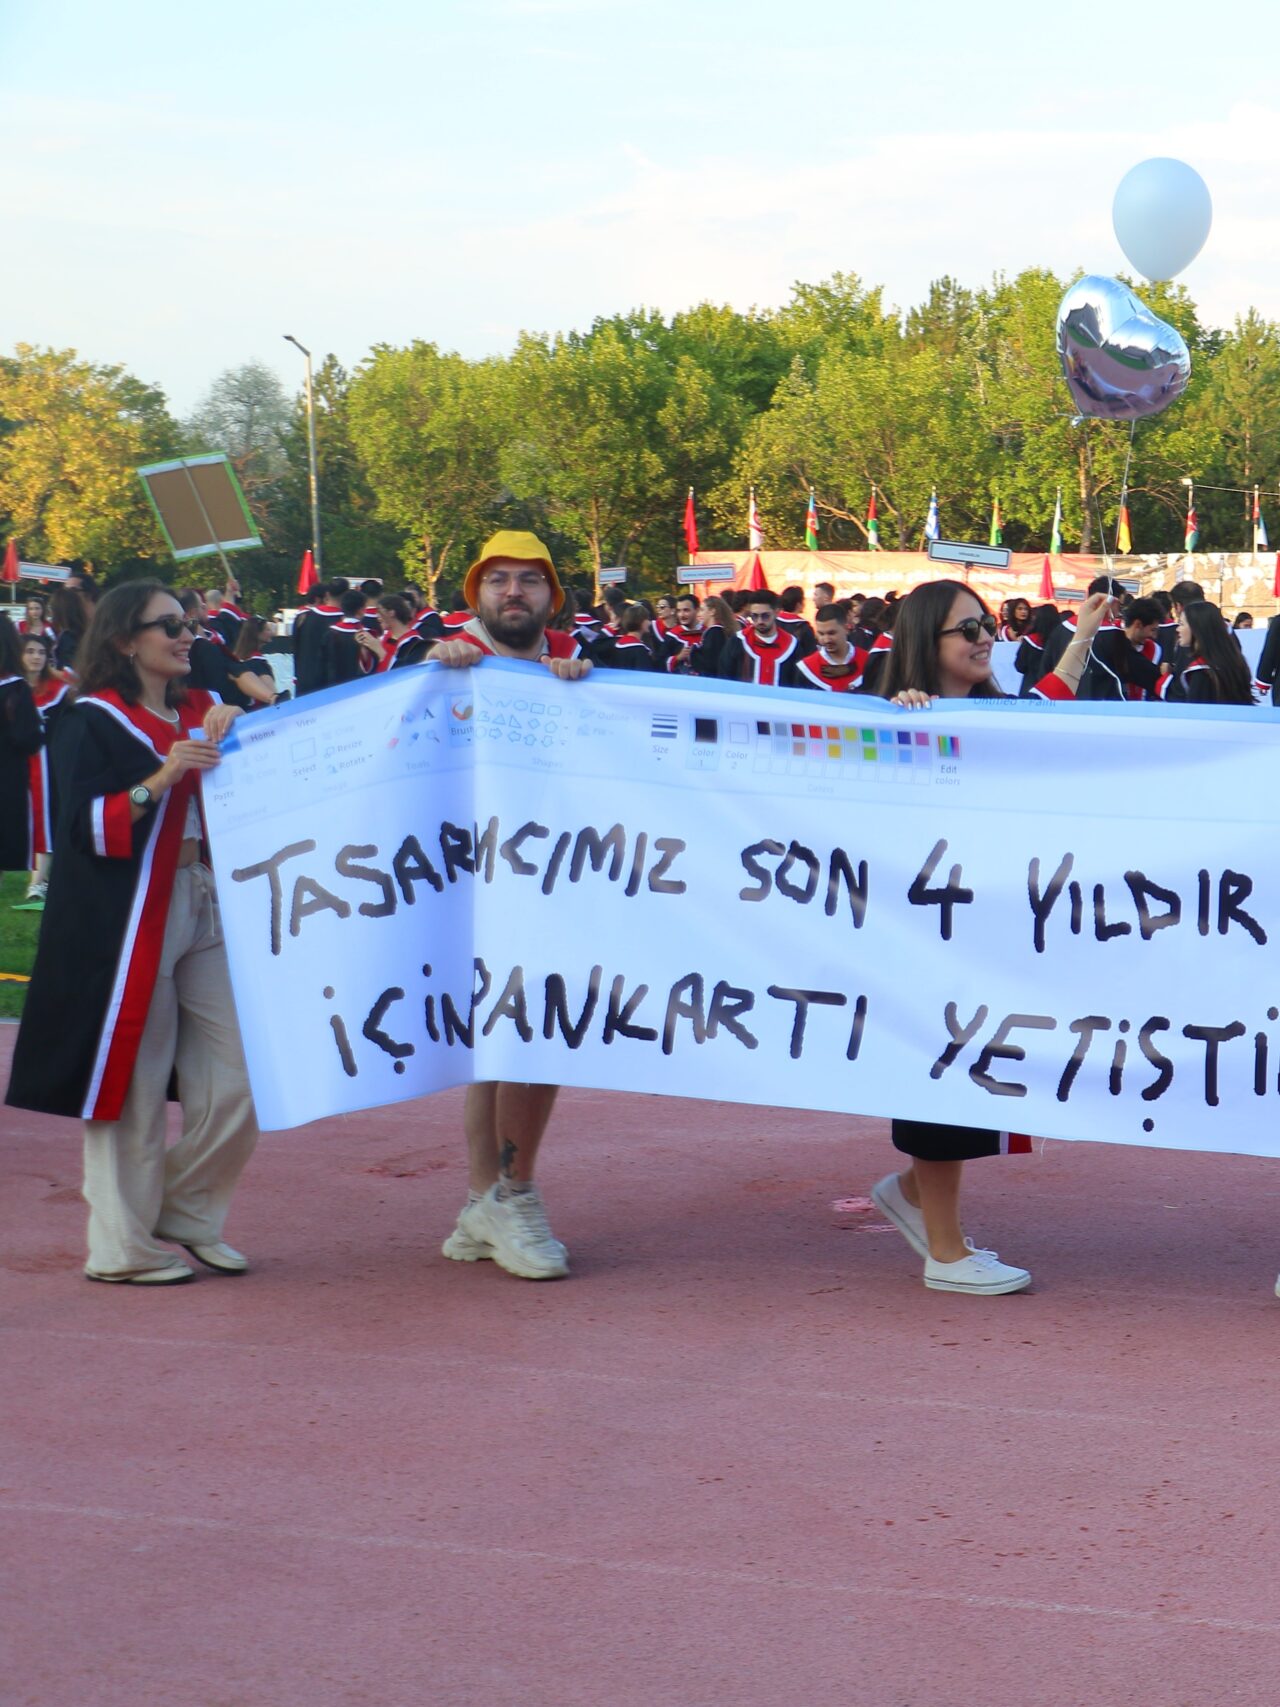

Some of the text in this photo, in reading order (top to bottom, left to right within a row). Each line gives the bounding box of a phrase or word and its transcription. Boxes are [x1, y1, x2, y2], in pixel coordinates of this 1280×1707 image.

[296, 717, 317, 728] View
[250, 729, 276, 743] Home
[652, 745, 669, 754] Size
[692, 748, 714, 757] Color
[726, 750, 748, 760] Color
[940, 764, 958, 774] Edit
[935, 776, 960, 785] colors
[232, 816, 686, 955] TASARMCIMIZ
[740, 840, 868, 929] SON
[908, 838, 974, 941] 4
[1029, 851, 1267, 953] YILDIR
